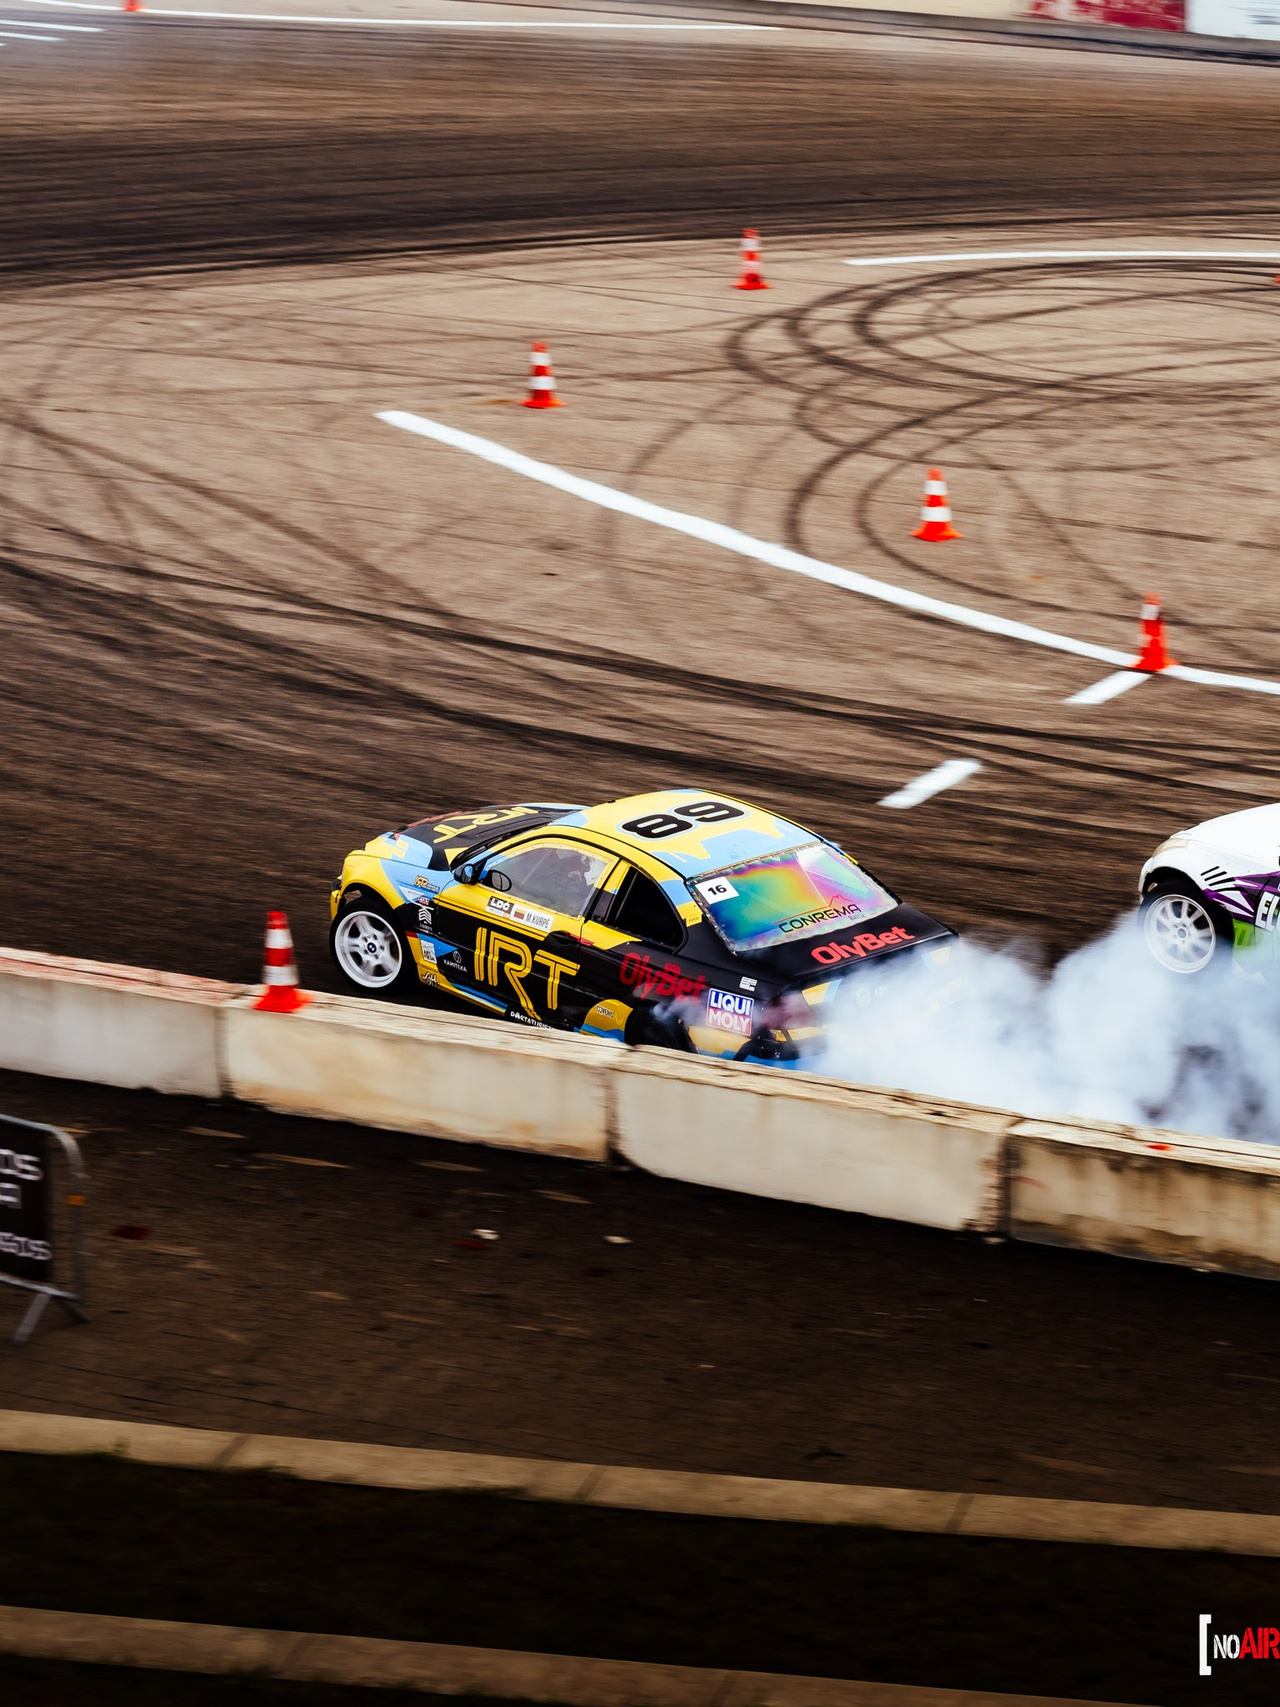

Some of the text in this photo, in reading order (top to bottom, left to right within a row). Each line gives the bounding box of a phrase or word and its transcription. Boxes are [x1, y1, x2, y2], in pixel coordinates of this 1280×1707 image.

[621, 801, 745, 839] 89
[707, 884, 727, 896] 16
[778, 903, 862, 933] CONREMA
[811, 926, 915, 964] OlyBet
[474, 926, 581, 1021] IRT
[619, 952, 706, 1004] OlyBet
[708, 1008, 750, 1032] MOLY
[710, 991, 750, 1016] LIQUI
